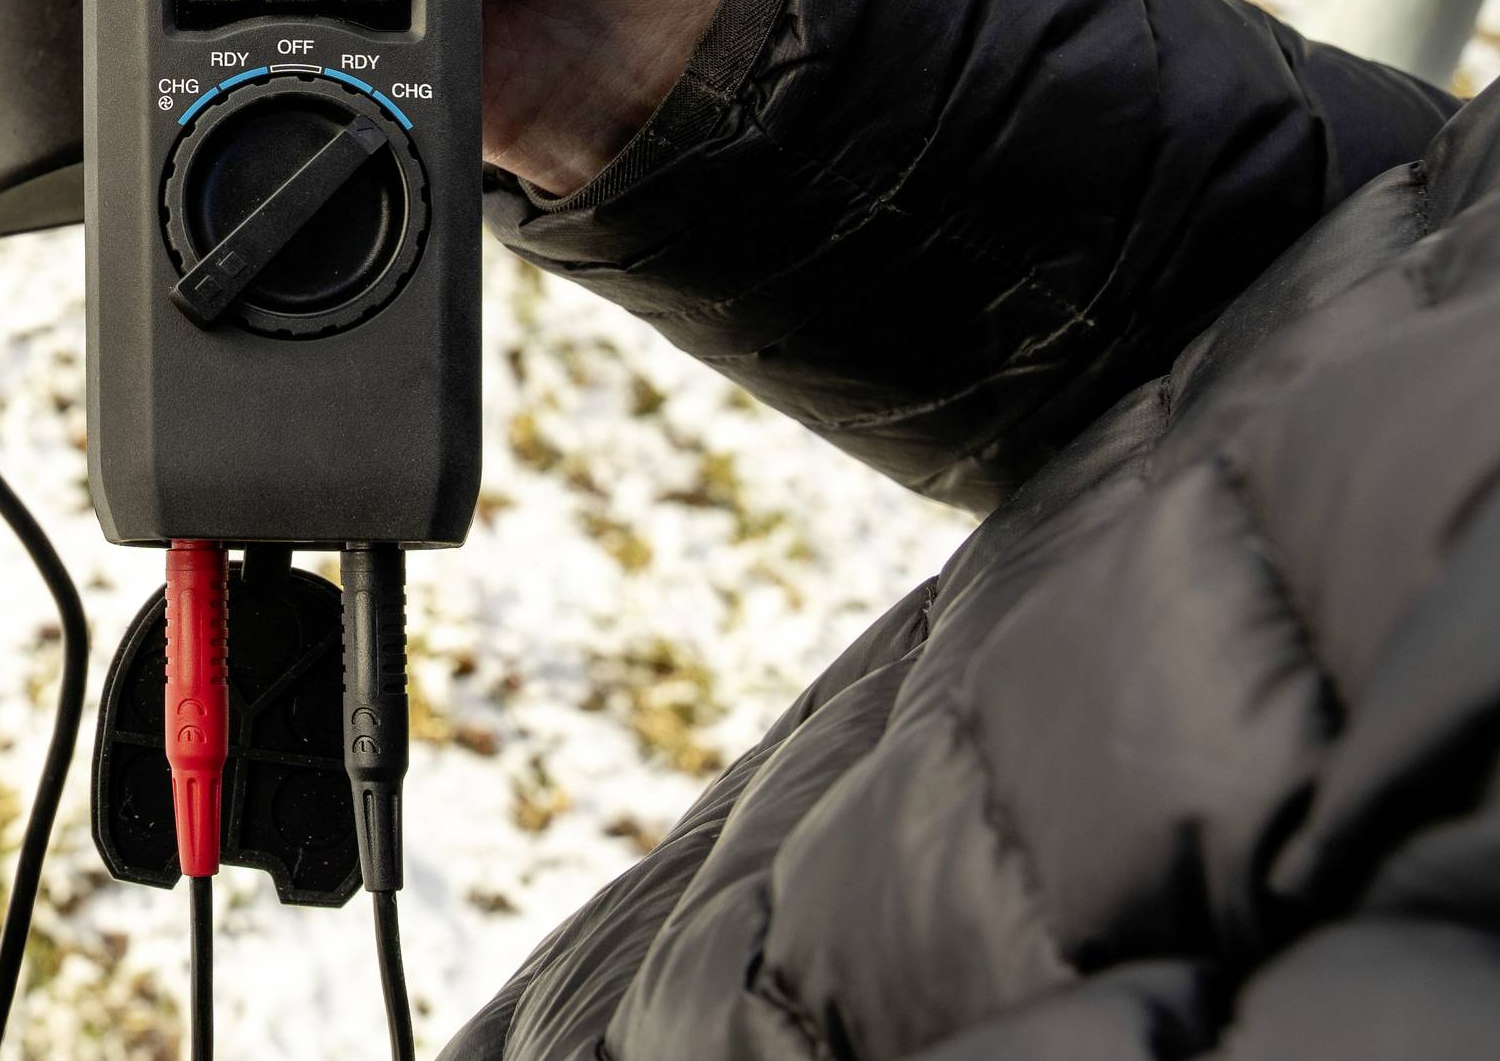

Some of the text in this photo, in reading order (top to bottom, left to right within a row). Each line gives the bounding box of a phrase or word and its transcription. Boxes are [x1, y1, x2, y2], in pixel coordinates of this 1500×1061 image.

[278, 40, 314, 54] OFF
[211, 52, 249, 66] RDY
[342, 55, 380, 69] RDY
[159, 79, 199, 93] CHG
[392, 83, 432, 98] CHG
